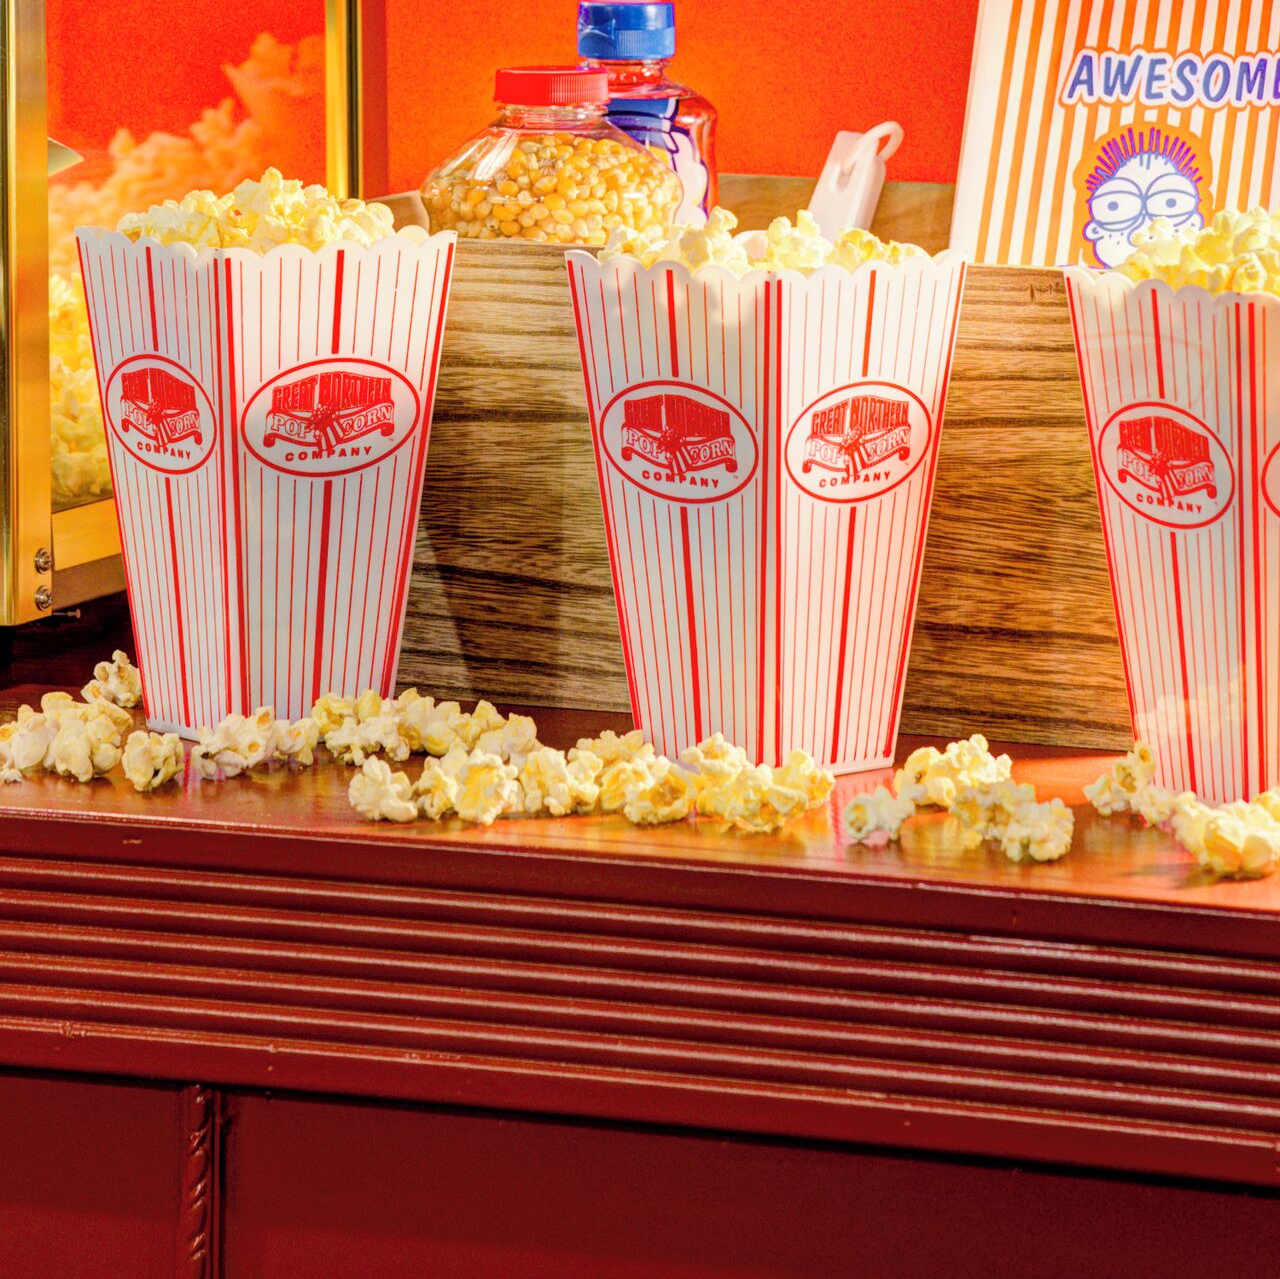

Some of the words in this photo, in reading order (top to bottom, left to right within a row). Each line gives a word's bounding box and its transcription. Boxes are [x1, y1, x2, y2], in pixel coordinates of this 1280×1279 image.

[272, 375, 319, 412] GREAT
[810, 399, 849, 436] GREAT
[850, 395, 909, 435] NORTHERN
[136, 441, 191, 460] COMPANY
[285, 445, 372, 462] COMPANY
[641, 470, 719, 488] COMPANY
[818, 470, 891, 488] COMPANY
[1136, 493, 1202, 514] COMPANY
